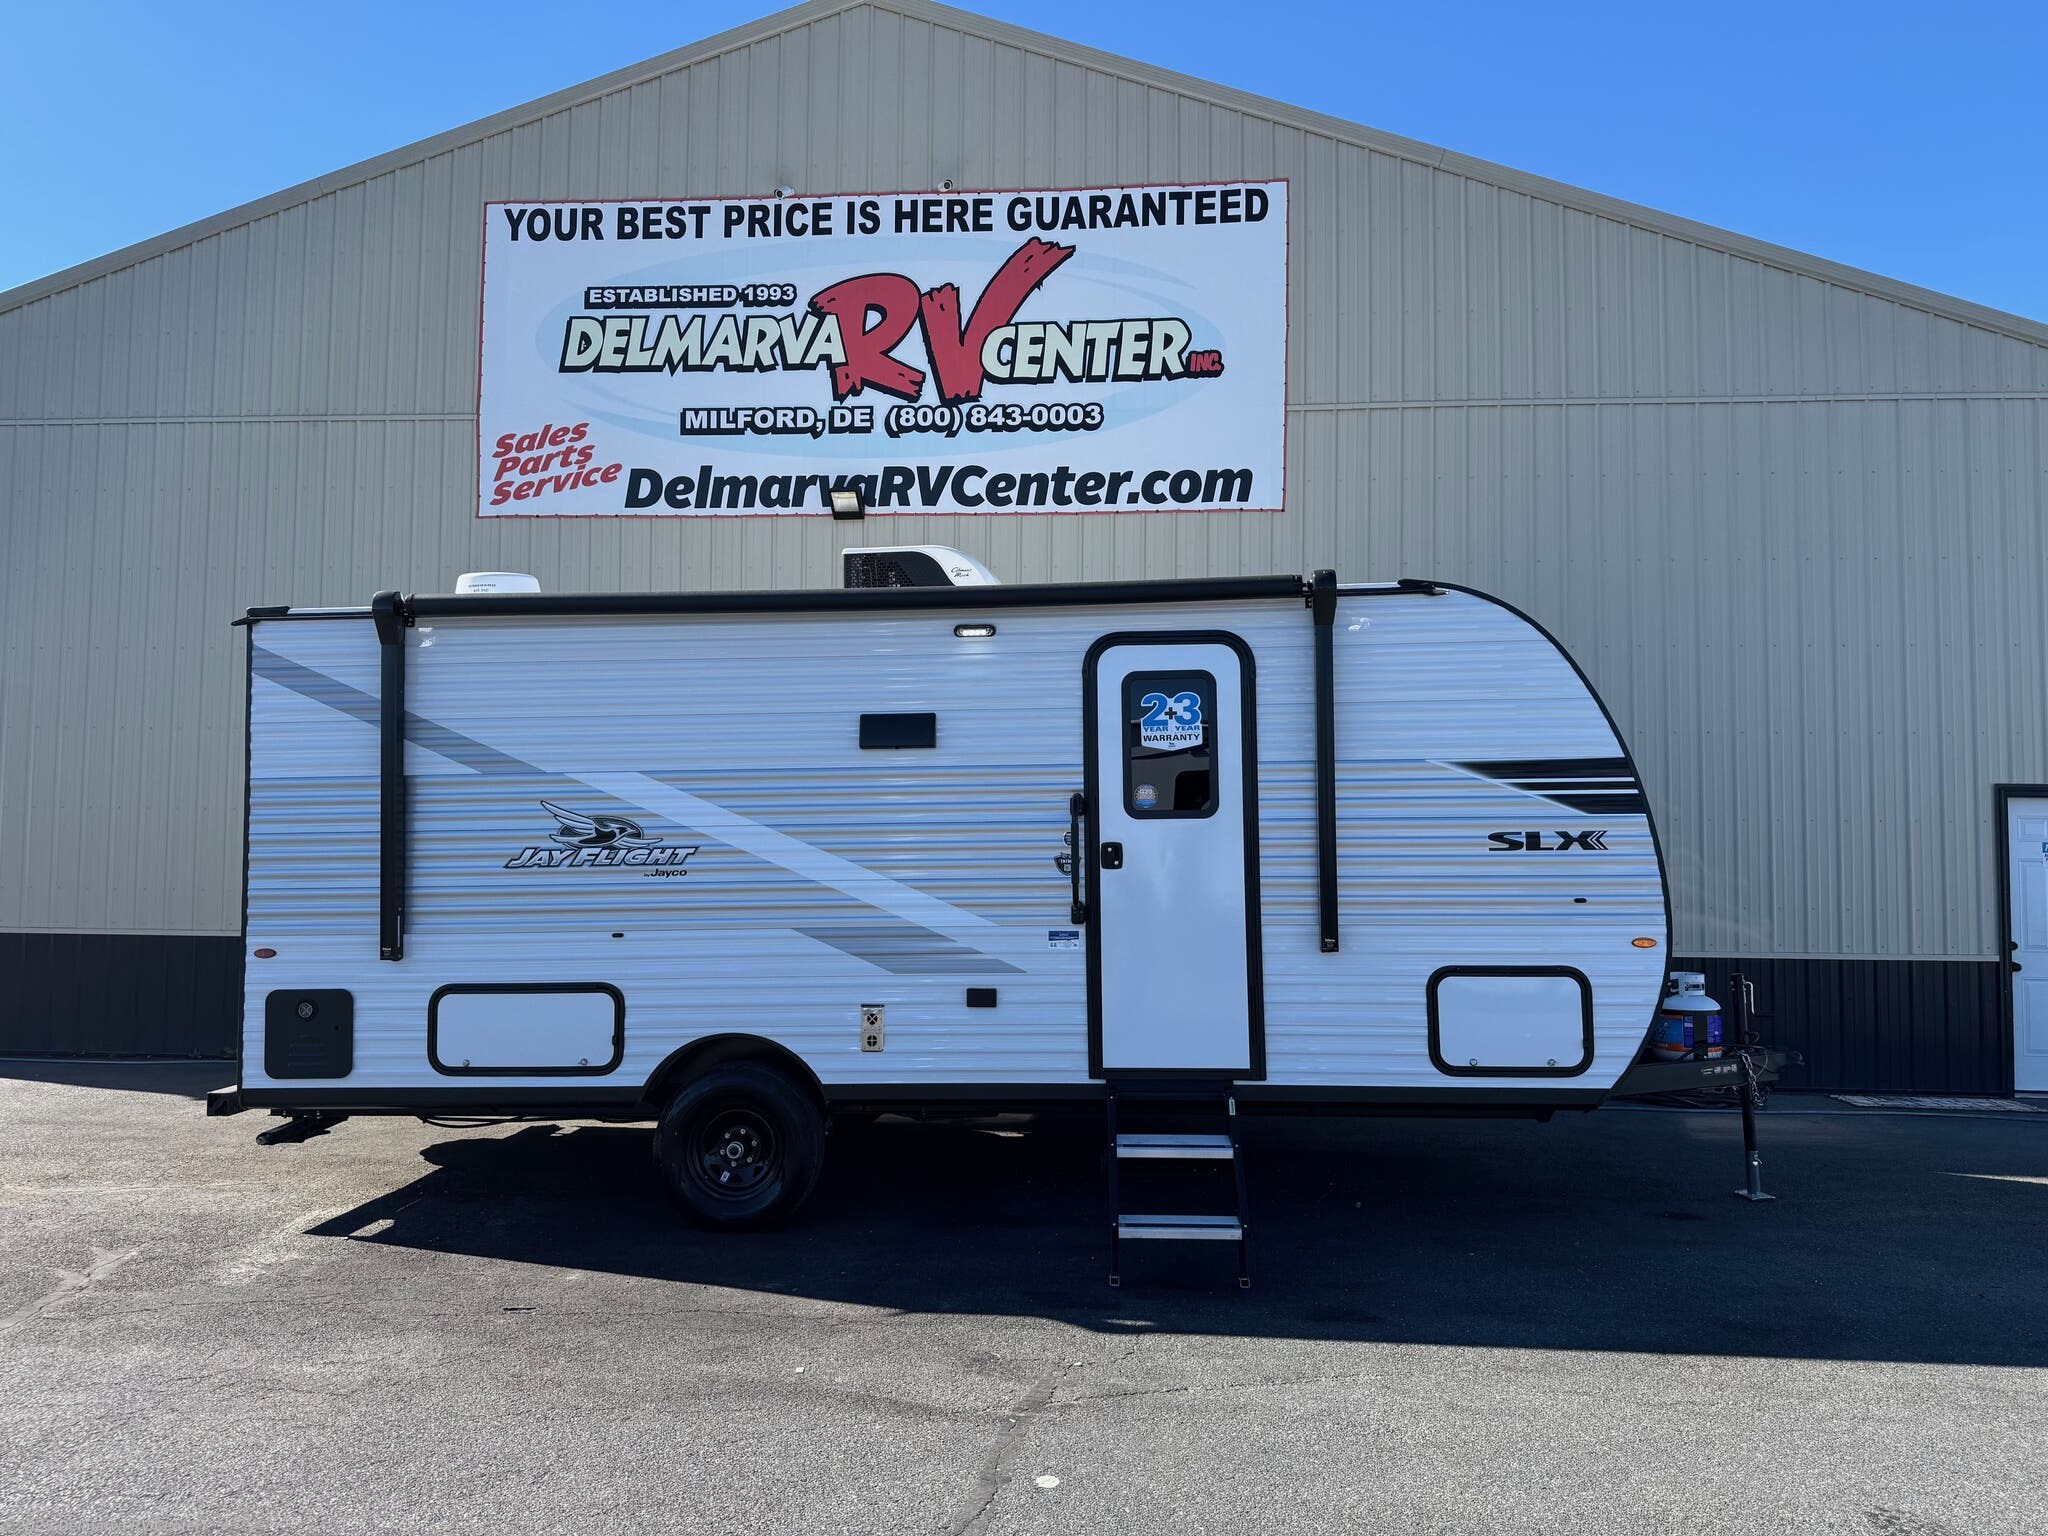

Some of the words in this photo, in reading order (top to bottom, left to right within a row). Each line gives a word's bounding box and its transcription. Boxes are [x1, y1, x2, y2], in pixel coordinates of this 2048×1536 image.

[504, 207, 604, 242] YOUR
[616, 205, 711, 241] BEST
[724, 201, 833, 238] PRICE
[847, 199, 881, 236] IS
[894, 198, 994, 234] HERE
[1006, 188, 1269, 232] GUARANTEED
[588, 286, 737, 305] ESTABLISHED
[743, 284, 796, 303] 1993
[561, 313, 849, 370] DELMARVA
[808, 237, 1077, 404] RV
[981, 319, 1190, 380] CENTER
[1189, 351, 1223, 373] INC.
[684, 408, 824, 435] MILFORD,
[832, 407, 873, 430] DE
[888, 406, 962, 434] (800)
[970, 405, 1102, 429] 843-0003
[492, 423, 590, 459] Sales
[493, 442, 595, 482] Parts
[489, 461, 623, 506] Service
[624, 464, 1254, 509] DelmarvaRVCenter.com
[1143, 725, 1169, 733] YEAR
[1143, 733, 1200, 742] WARRANTY
[1487, 830, 1609, 852] SLX
[650, 868, 688, 879] Jayco
